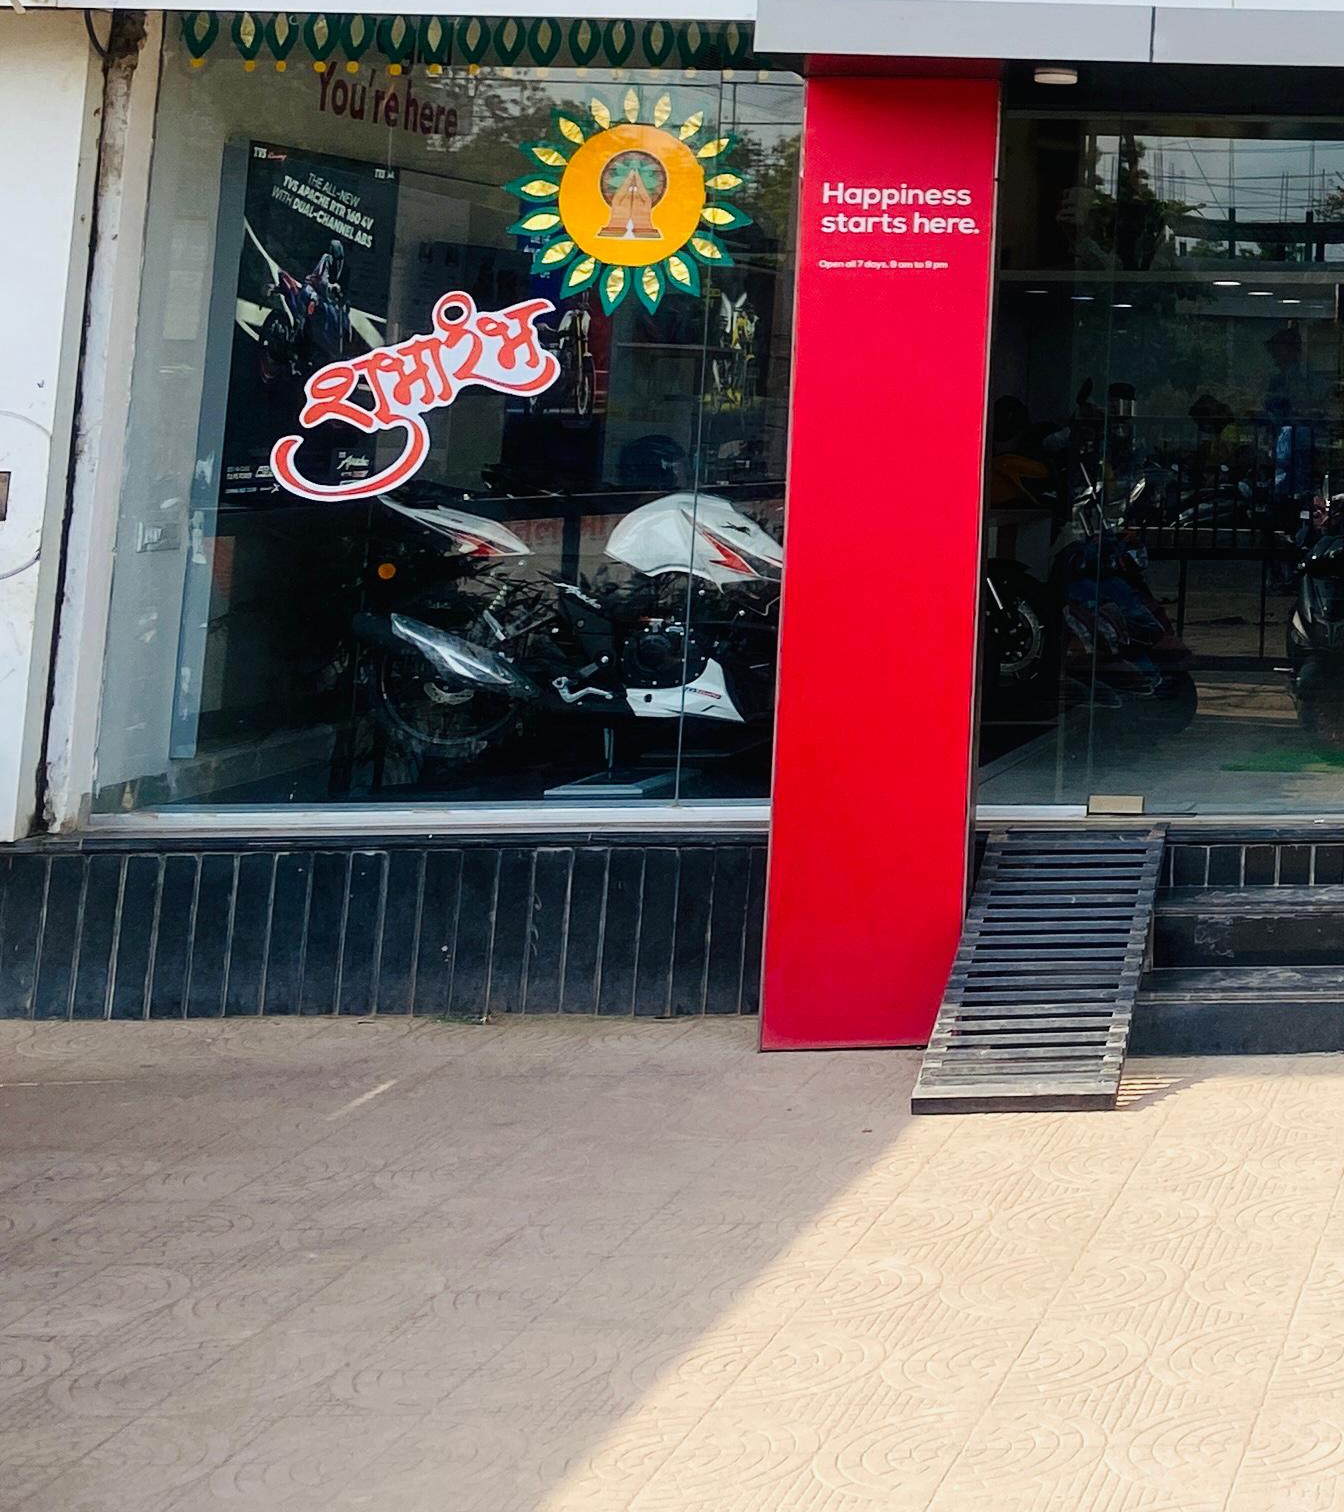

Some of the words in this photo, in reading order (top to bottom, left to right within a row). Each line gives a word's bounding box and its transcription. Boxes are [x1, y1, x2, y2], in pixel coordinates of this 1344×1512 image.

[319, 61, 399, 127] You're
[403, 79, 458, 137] here
[283, 175, 300, 192] TVS
[298, 184, 330, 207] APACHE
[329, 201, 347, 219] RTR
[308, 172, 325, 189] THE
[822, 182, 972, 210] Happiness
[292, 197, 355, 241] DUAL-CHANNEL
[354, 230, 374, 249] ABS
[821, 213, 907, 234] starts
[913, 211, 980, 235] here.
[819, 259, 844, 270] Open
[271, 291, 560, 501] शुभारंभ
